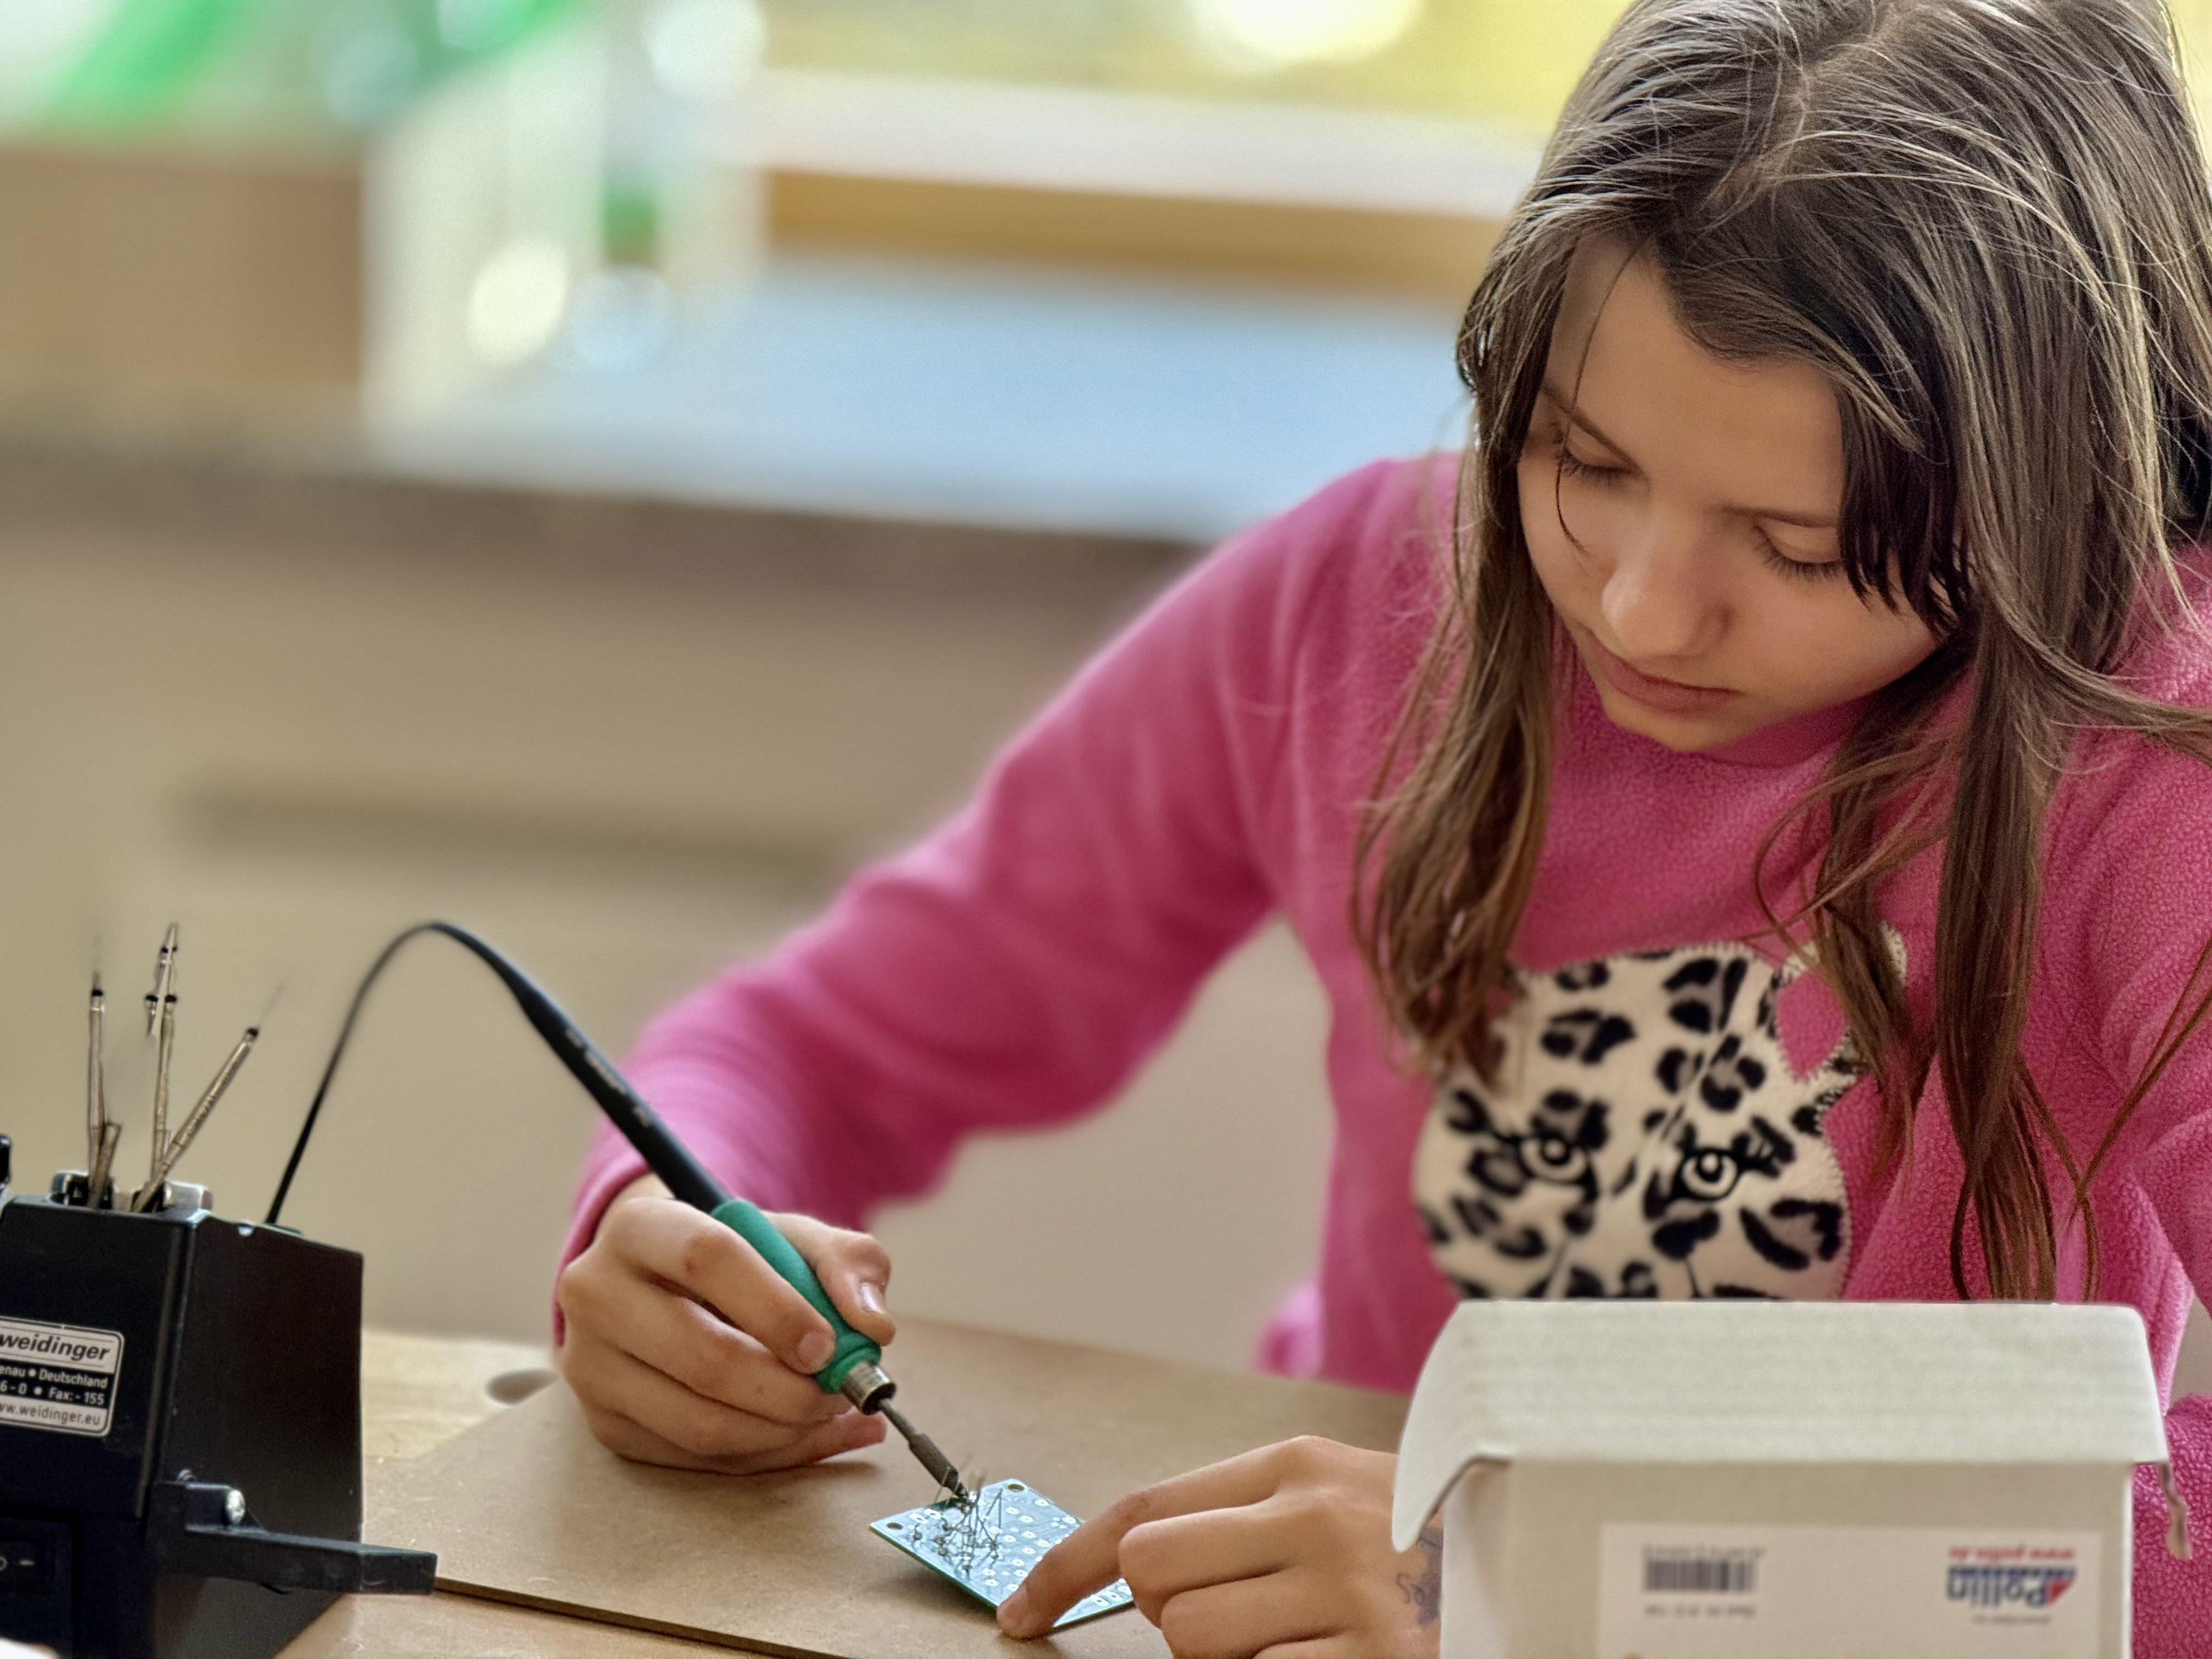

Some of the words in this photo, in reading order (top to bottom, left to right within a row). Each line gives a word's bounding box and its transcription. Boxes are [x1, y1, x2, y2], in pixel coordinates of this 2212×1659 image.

[0, 1334, 110, 1361] weidinger
[39, 1369, 109, 1389] Deutschland
[49, 1386, 74, 1401] Fax:
[84, 1391, 105, 1405] 155
[1946, 1567, 2049, 1607] Pollin
